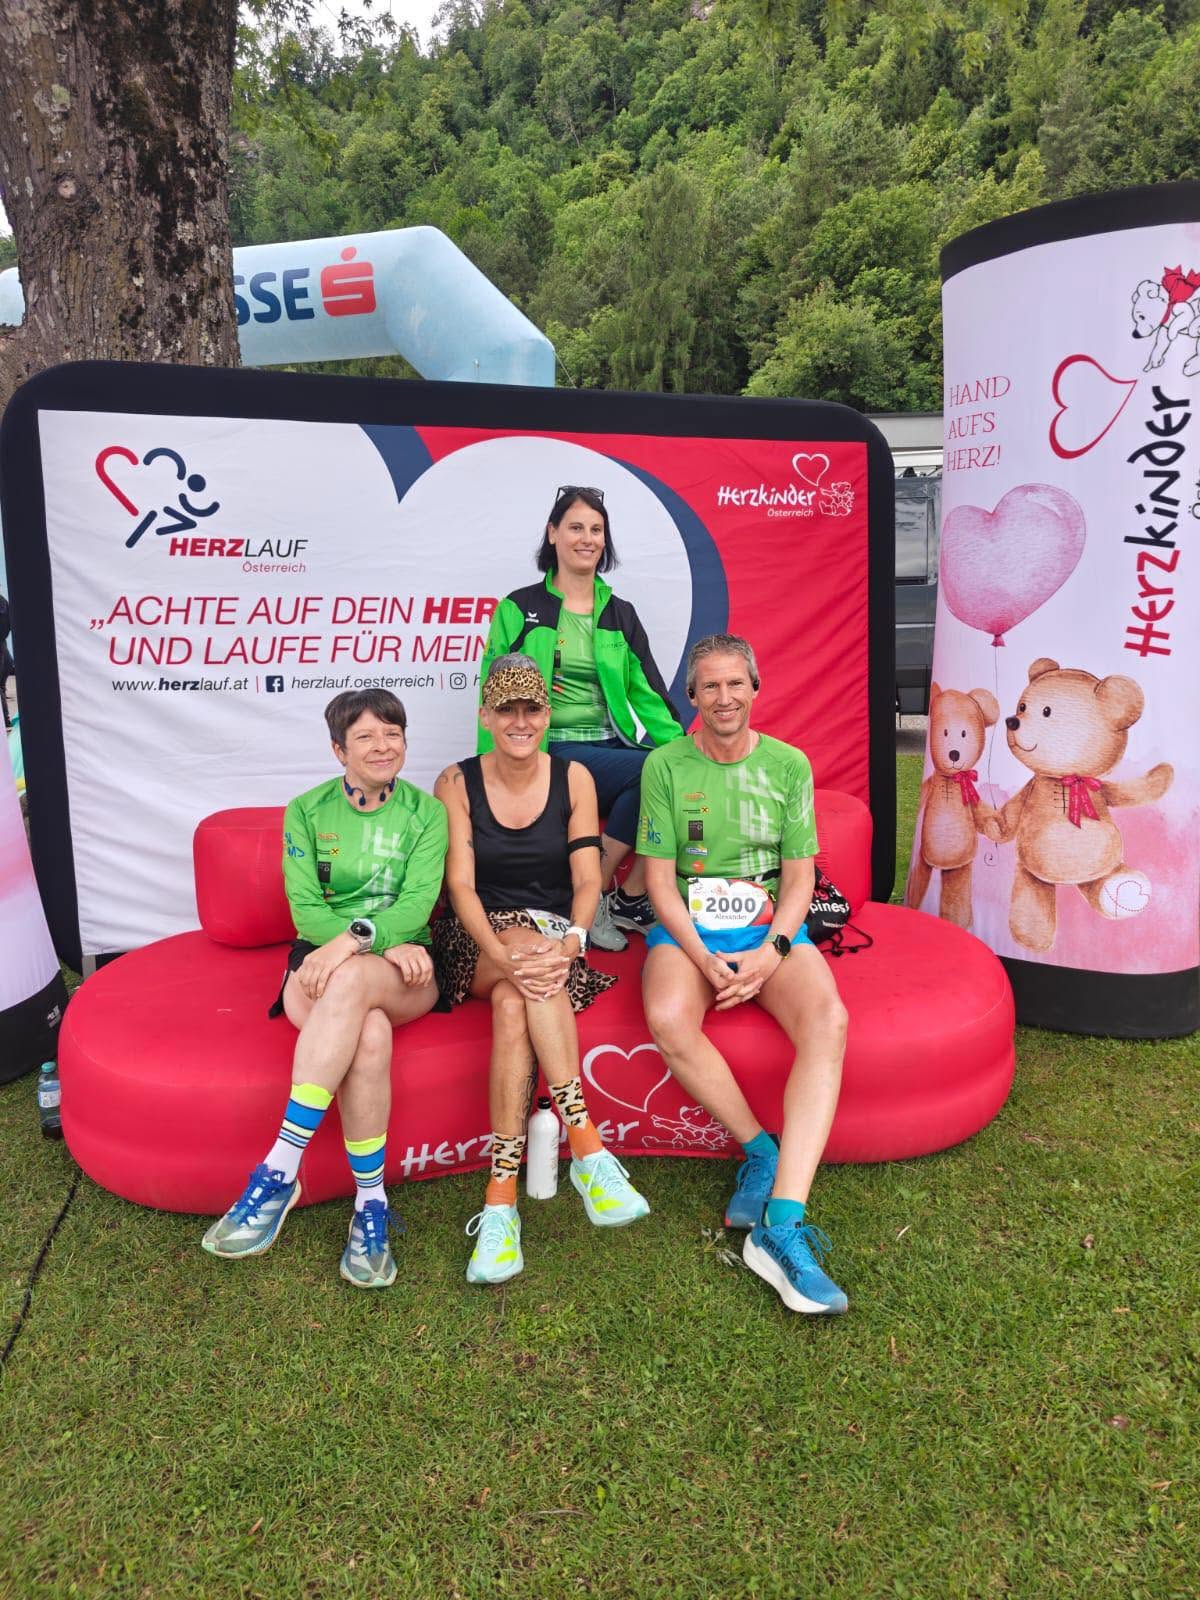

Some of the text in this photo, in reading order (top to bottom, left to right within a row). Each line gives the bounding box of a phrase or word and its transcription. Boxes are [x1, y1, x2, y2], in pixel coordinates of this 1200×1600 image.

[949, 375, 1012, 408] HAND
[947, 411, 996, 440] AUFS
[946, 444, 1001, 472] HERZ!
[717, 483, 816, 507] Herzkinder
[767, 508, 814, 517] Österreich
[1124, 385, 1192, 657] Herzkinder
[169, 537, 309, 558] HERZLAUF
[242, 560, 306, 573] Österreich
[247, 596, 323, 625] AUF
[331, 596, 415, 625] DEIN
[109, 636, 193, 665] UND
[204, 635, 322, 665] LAUFE
[330, 629, 402, 664] FÜR
[112, 677, 249, 691] www.herzlauf.at
[291, 674, 435, 689] herzlauf.oesterreich
[705, 897, 756, 913] 2000
